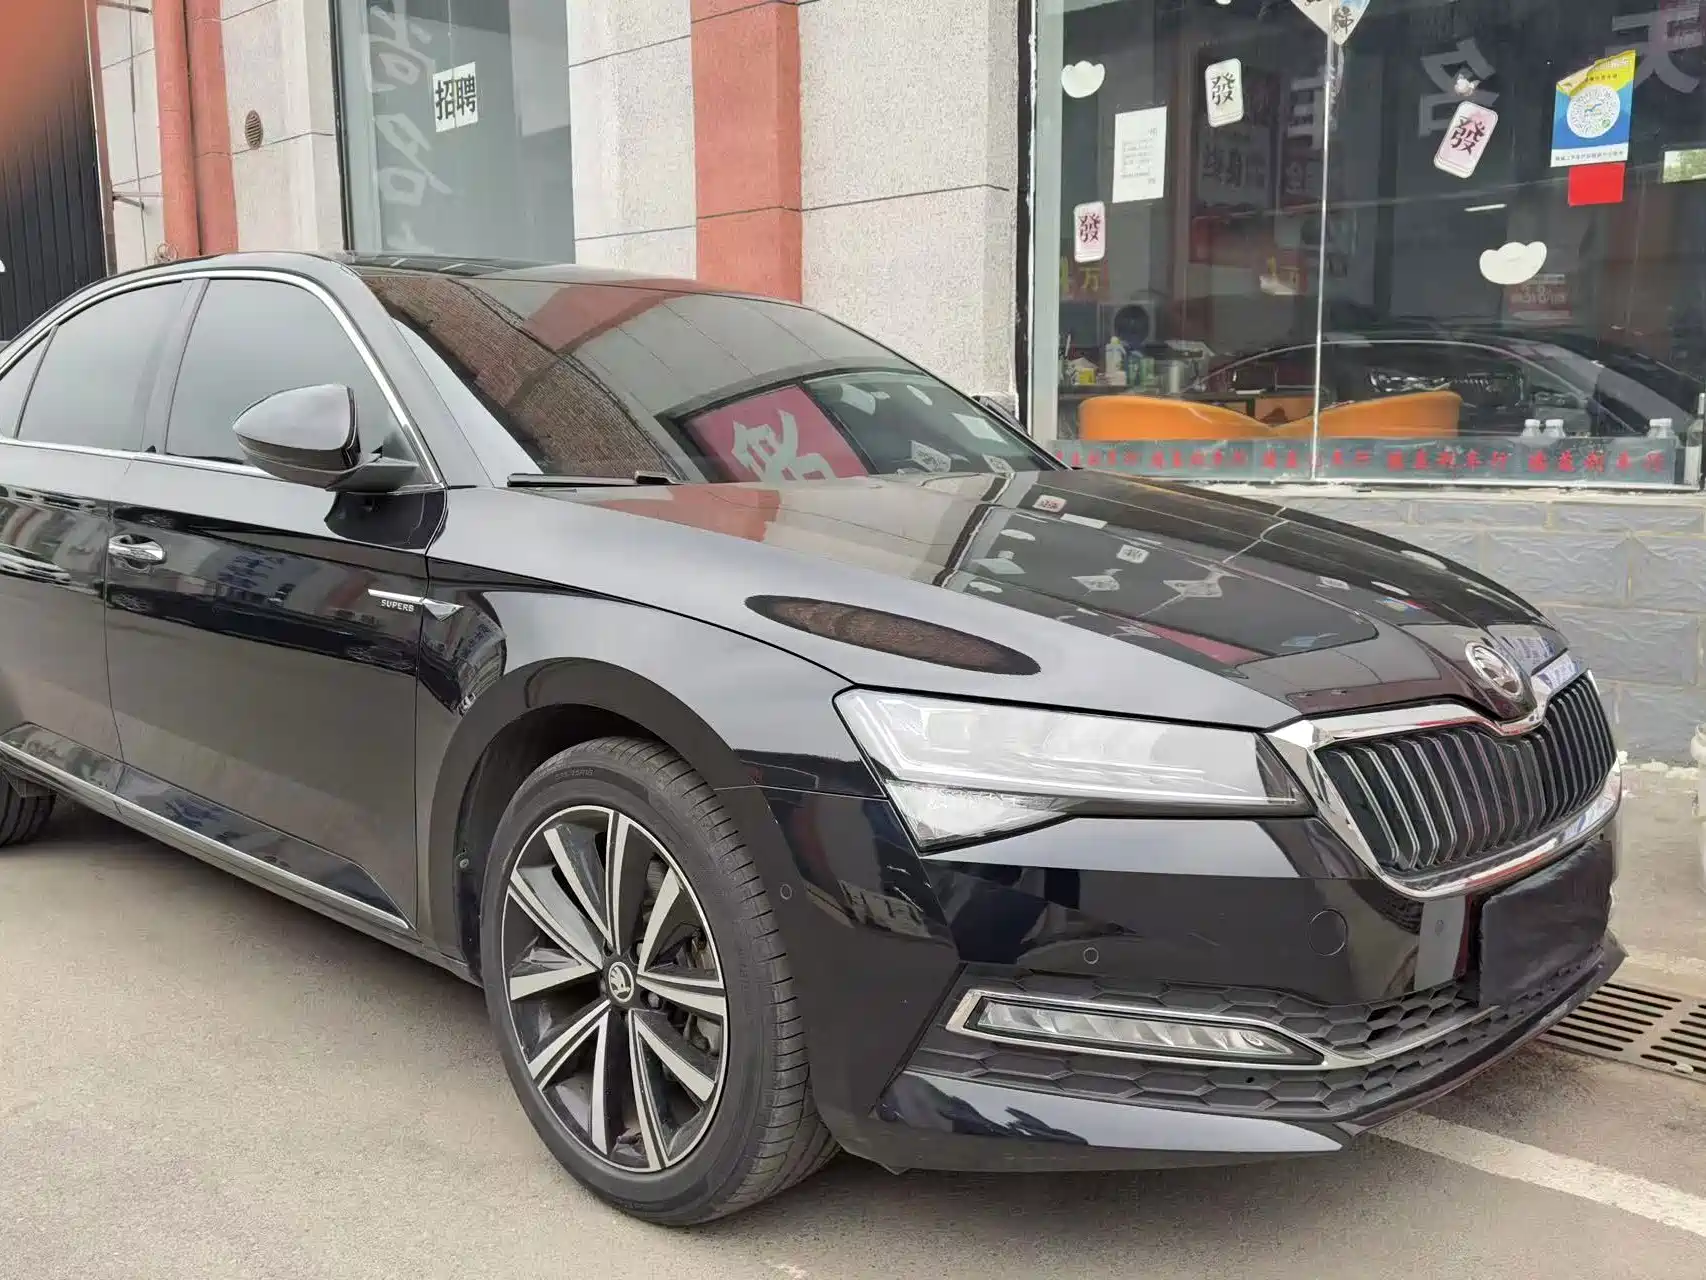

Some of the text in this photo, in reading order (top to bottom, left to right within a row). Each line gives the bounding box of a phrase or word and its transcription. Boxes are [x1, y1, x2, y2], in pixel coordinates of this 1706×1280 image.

[435, 73, 477, 121] 招聘
[1211, 71, 1236, 106] 發
[1450, 114, 1486, 156] 發
[1079, 212, 1102, 244] 發
[381, 599, 415, 612] SUPERB
